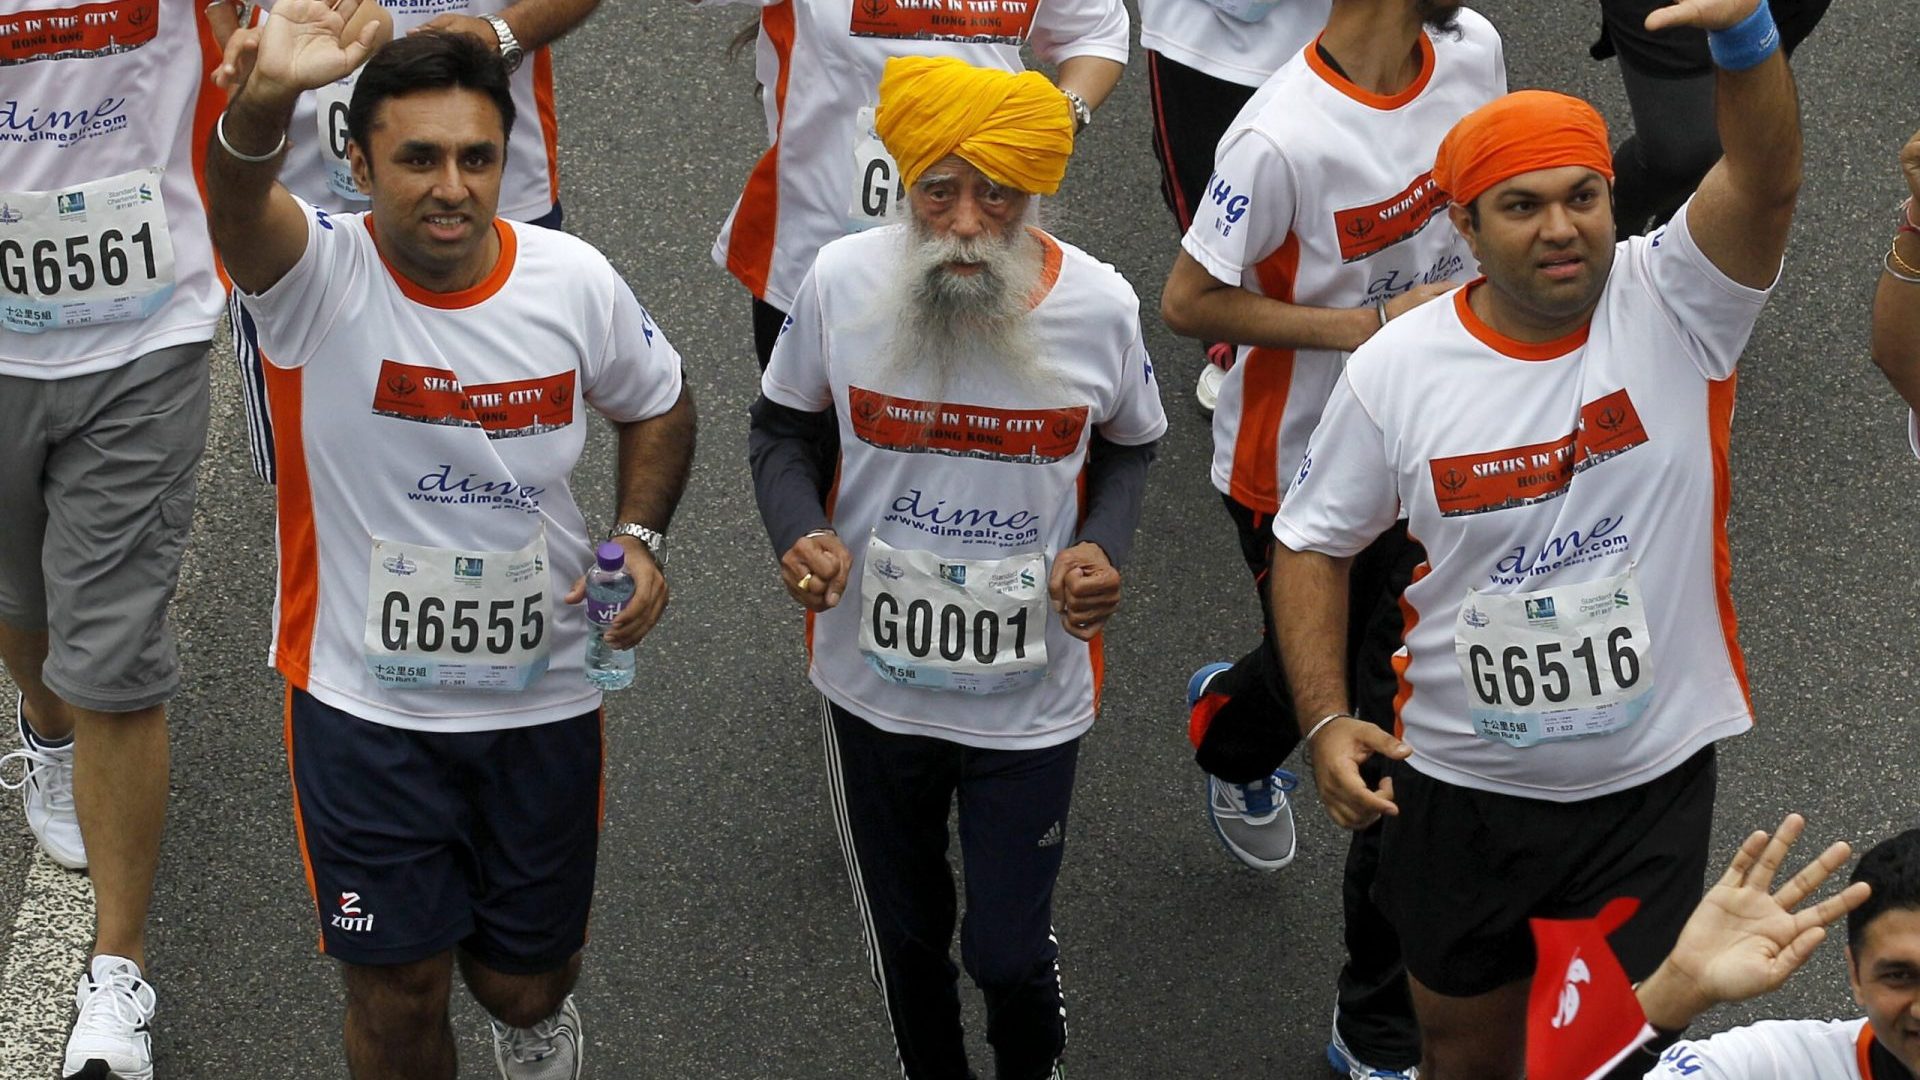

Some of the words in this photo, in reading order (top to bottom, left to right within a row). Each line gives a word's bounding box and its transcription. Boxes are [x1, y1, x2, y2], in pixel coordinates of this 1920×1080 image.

[966, 0, 999, 13] THE
[1002, 2, 1028, 14] CITY
[25, 18, 42, 32] IN
[47, 15, 79, 29] THE
[84, 10, 119, 26] CITY
[931, 15, 966, 27] HONG
[970, 16, 1002, 28] KONG
[11, 35, 47, 50] HONG
[51, 31, 84, 45] KONG
[0, 222, 157, 296] G6561
[6, 306, 52, 320] 十公里5組
[469, 393, 502, 408] THE
[508, 388, 544, 405] CITY
[886, 405, 935, 422] SIKHS
[942, 412, 961, 426] IN
[966, 414, 1000, 431] THE
[1006, 418, 1045, 433] CITY
[967, 432, 1003, 446] KONG
[1472, 456, 1526, 478] SIKHS
[1530, 452, 1551, 469] IN
[1517, 472, 1556, 488] HONG
[892, 489, 1039, 530] dime
[884, 514, 1039, 541] www.dimeair.com
[381, 590, 544, 655] G6555
[872, 591, 1028, 665] G0001
[375, 664, 427, 678] 十公里5組
[1469, 626, 1640, 707] G6516
[1481, 718, 1528, 733] 十公里5組
